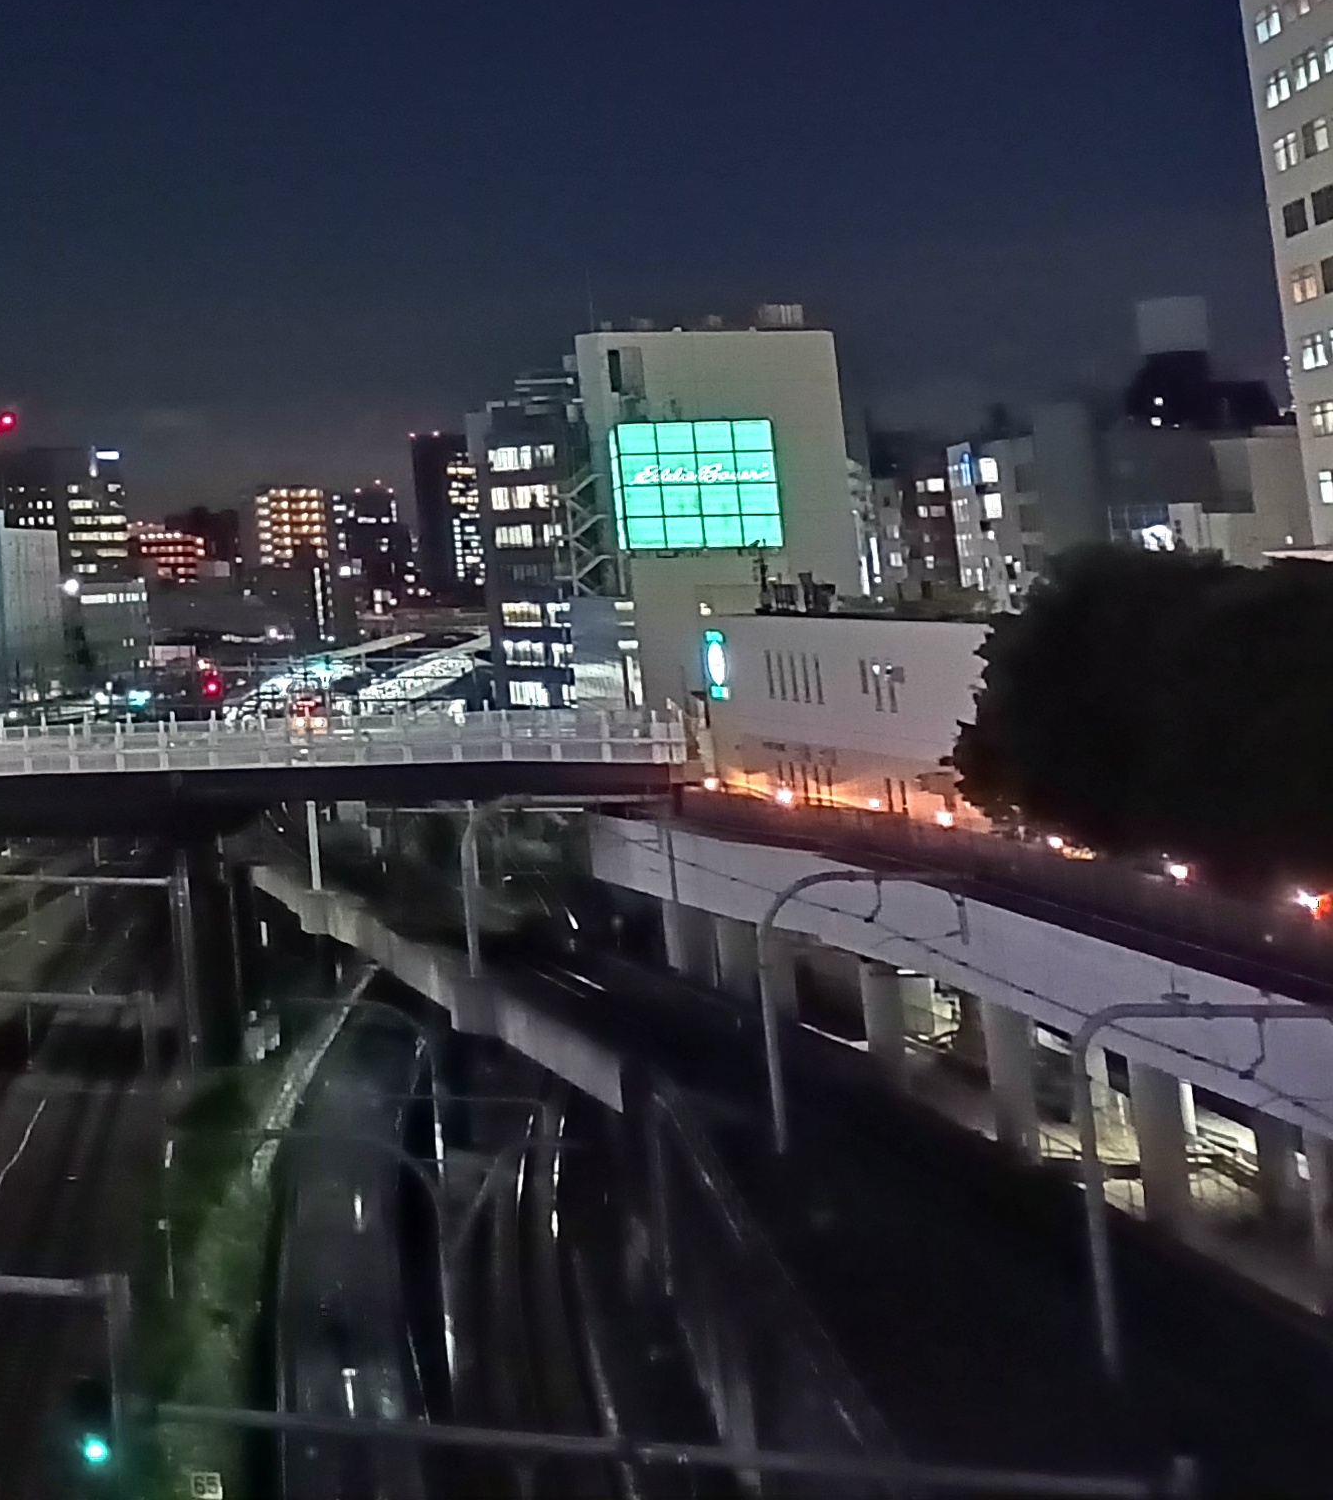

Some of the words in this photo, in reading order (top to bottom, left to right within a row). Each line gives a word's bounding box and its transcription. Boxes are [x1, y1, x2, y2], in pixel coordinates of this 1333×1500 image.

[629, 463, 697, 485] Eddie
[698, 463, 770, 483] Bauer
[194, 1475, 219, 1495] 65
